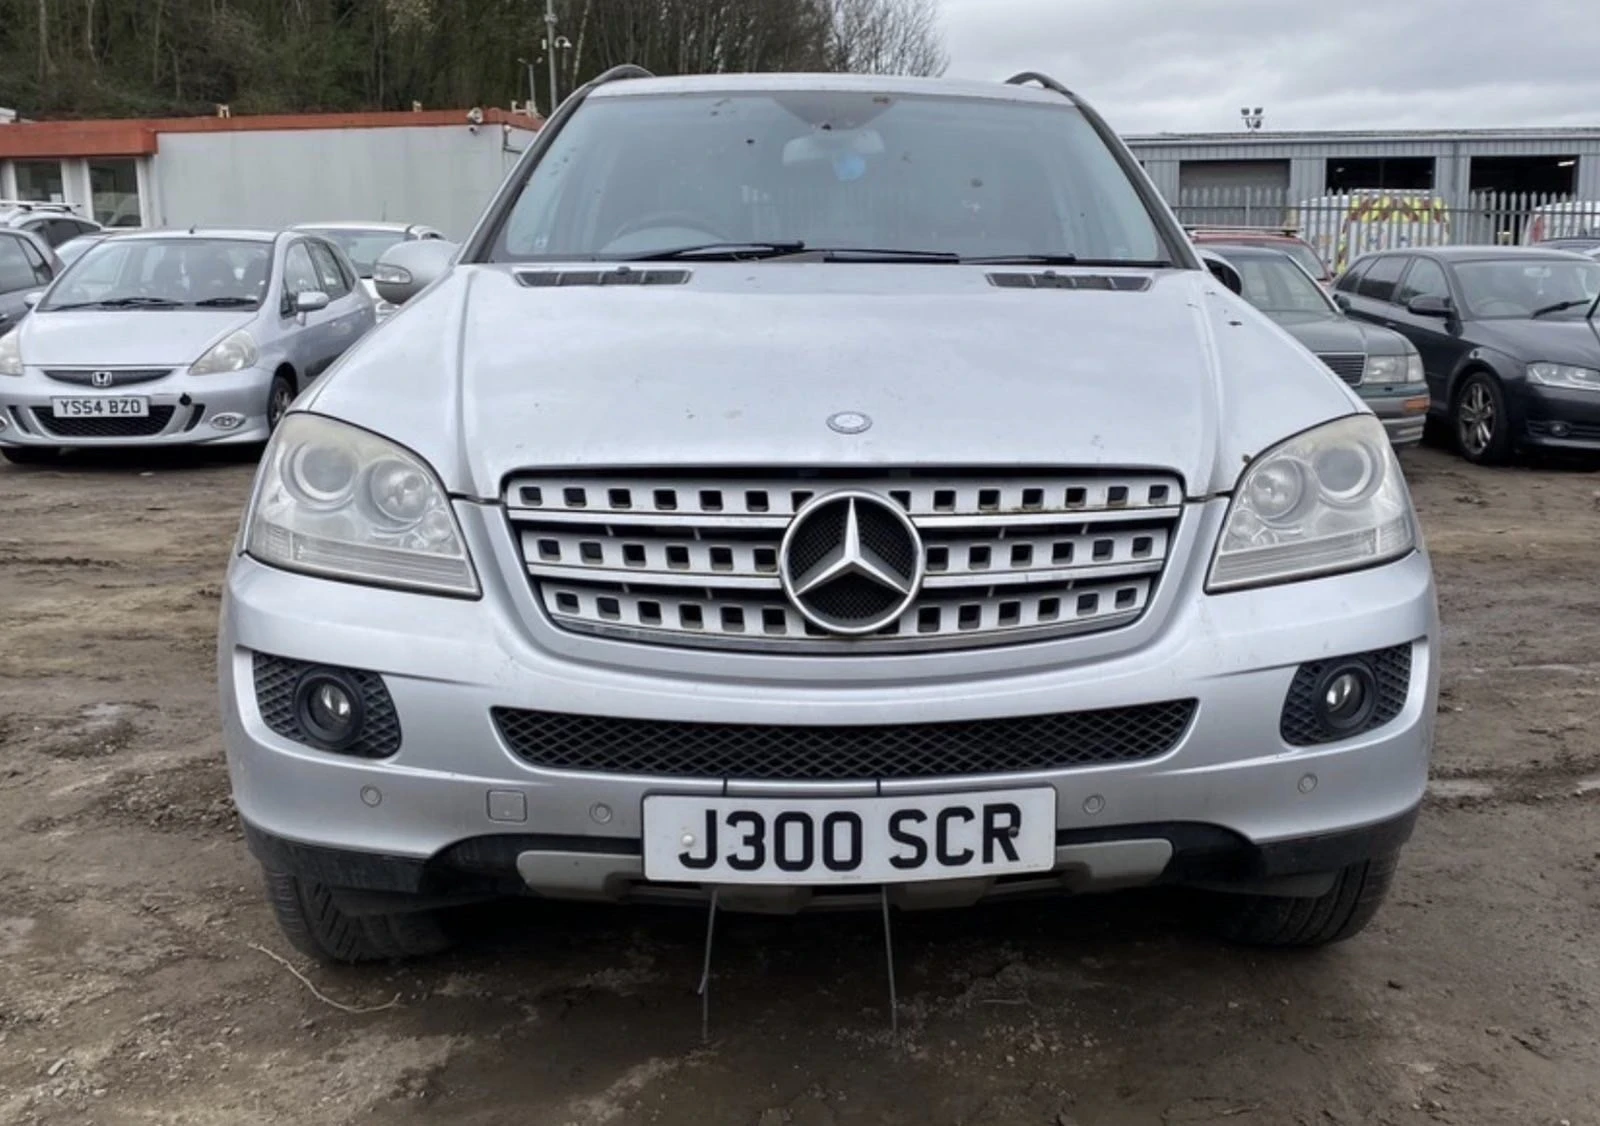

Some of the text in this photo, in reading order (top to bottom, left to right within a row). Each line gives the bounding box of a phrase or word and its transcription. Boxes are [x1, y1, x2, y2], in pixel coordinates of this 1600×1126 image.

[60, 400, 103, 415] YS54
[678, 802, 1022, 872] J300 SCR
